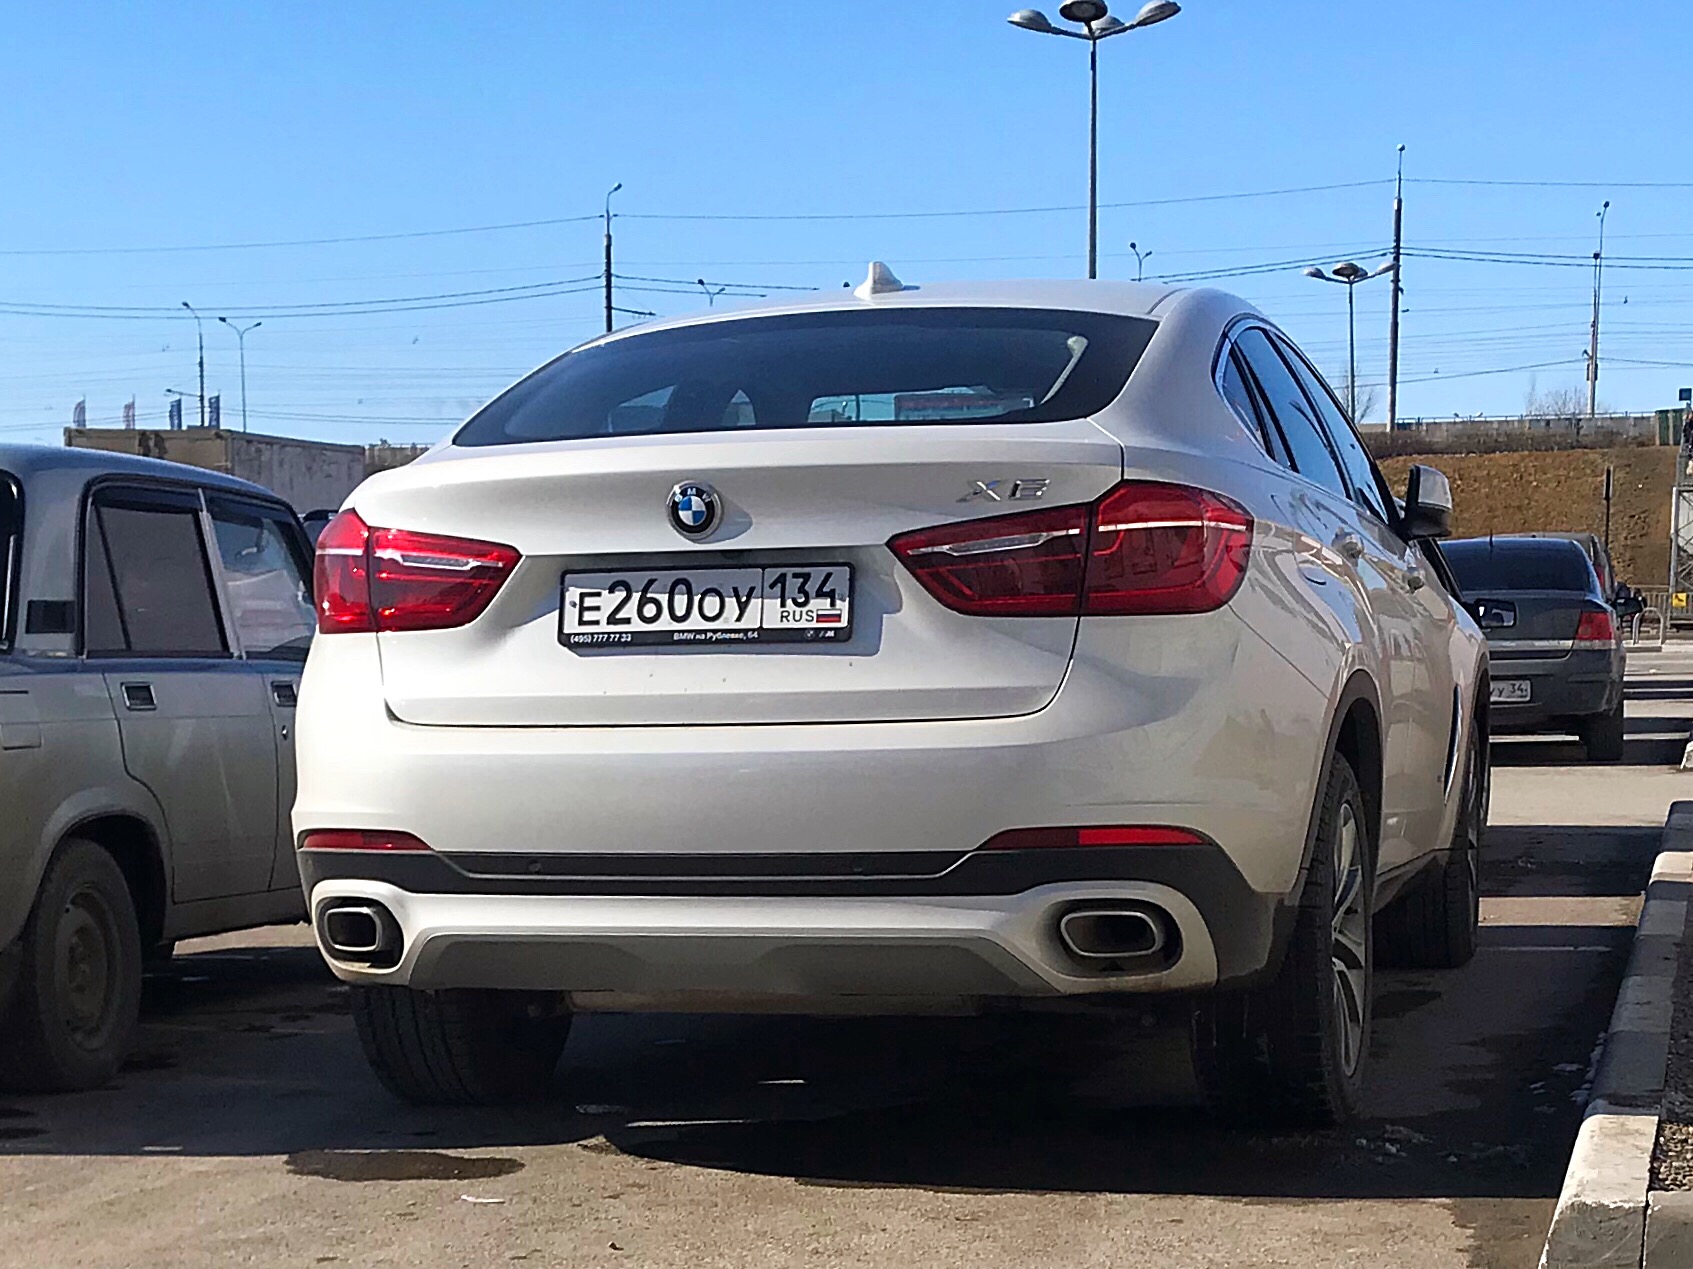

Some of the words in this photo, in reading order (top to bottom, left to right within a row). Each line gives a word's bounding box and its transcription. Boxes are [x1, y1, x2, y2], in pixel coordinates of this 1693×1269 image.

[769, 572, 837, 608] 134
[780, 609, 814, 623] RUS
[570, 634, 592, 643] (495)
[593, 634, 608, 643] 777
[609, 634, 620, 642] 77
[620, 633, 632, 642] 33
